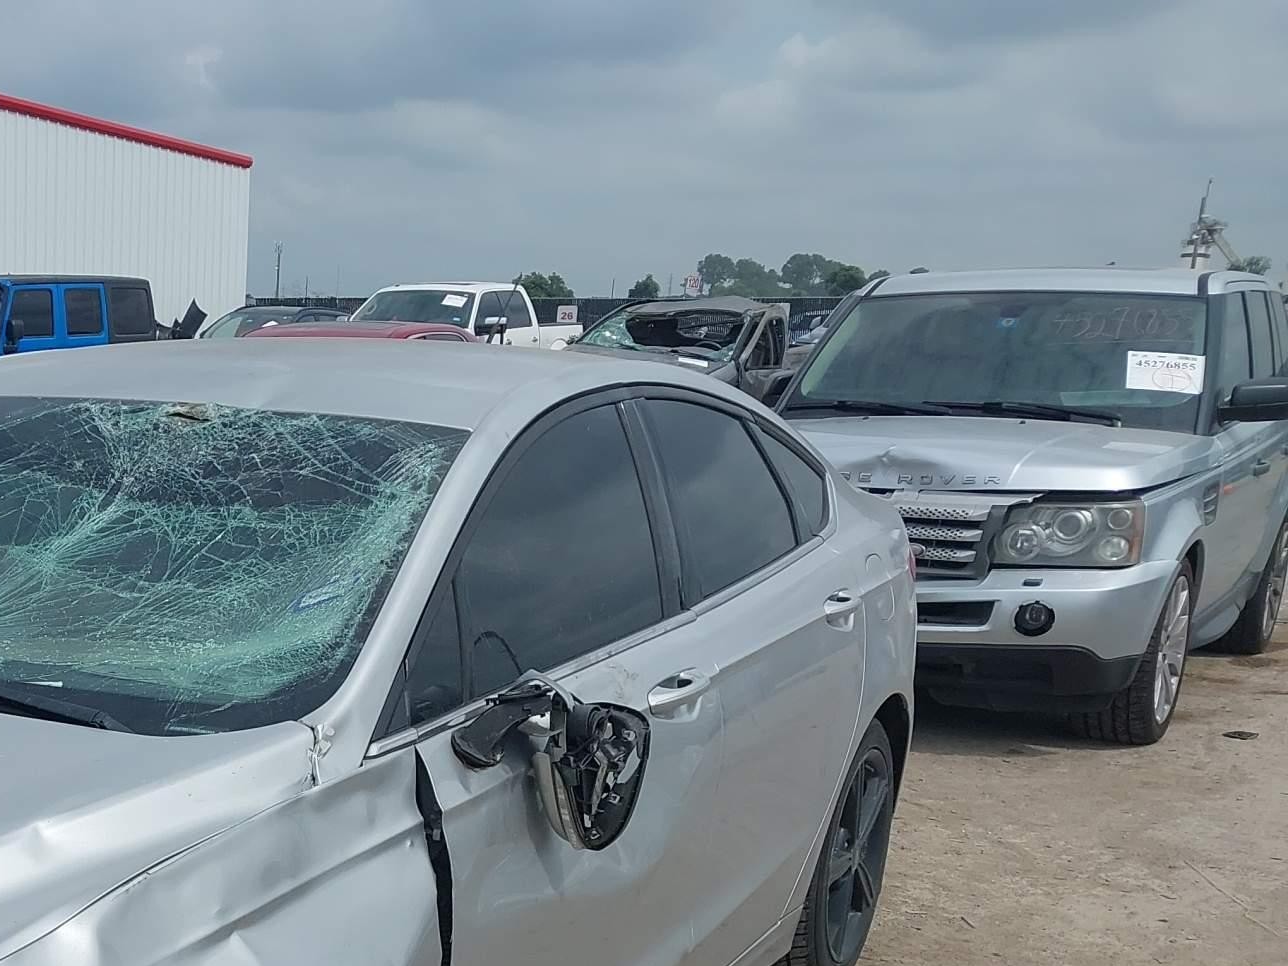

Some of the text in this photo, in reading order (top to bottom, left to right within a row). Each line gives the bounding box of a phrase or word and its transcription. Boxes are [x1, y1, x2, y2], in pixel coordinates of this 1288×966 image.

[560, 311, 573, 320] 26
[1136, 360, 1197, 371] 45276855
[897, 473, 1001, 486] ROVER
